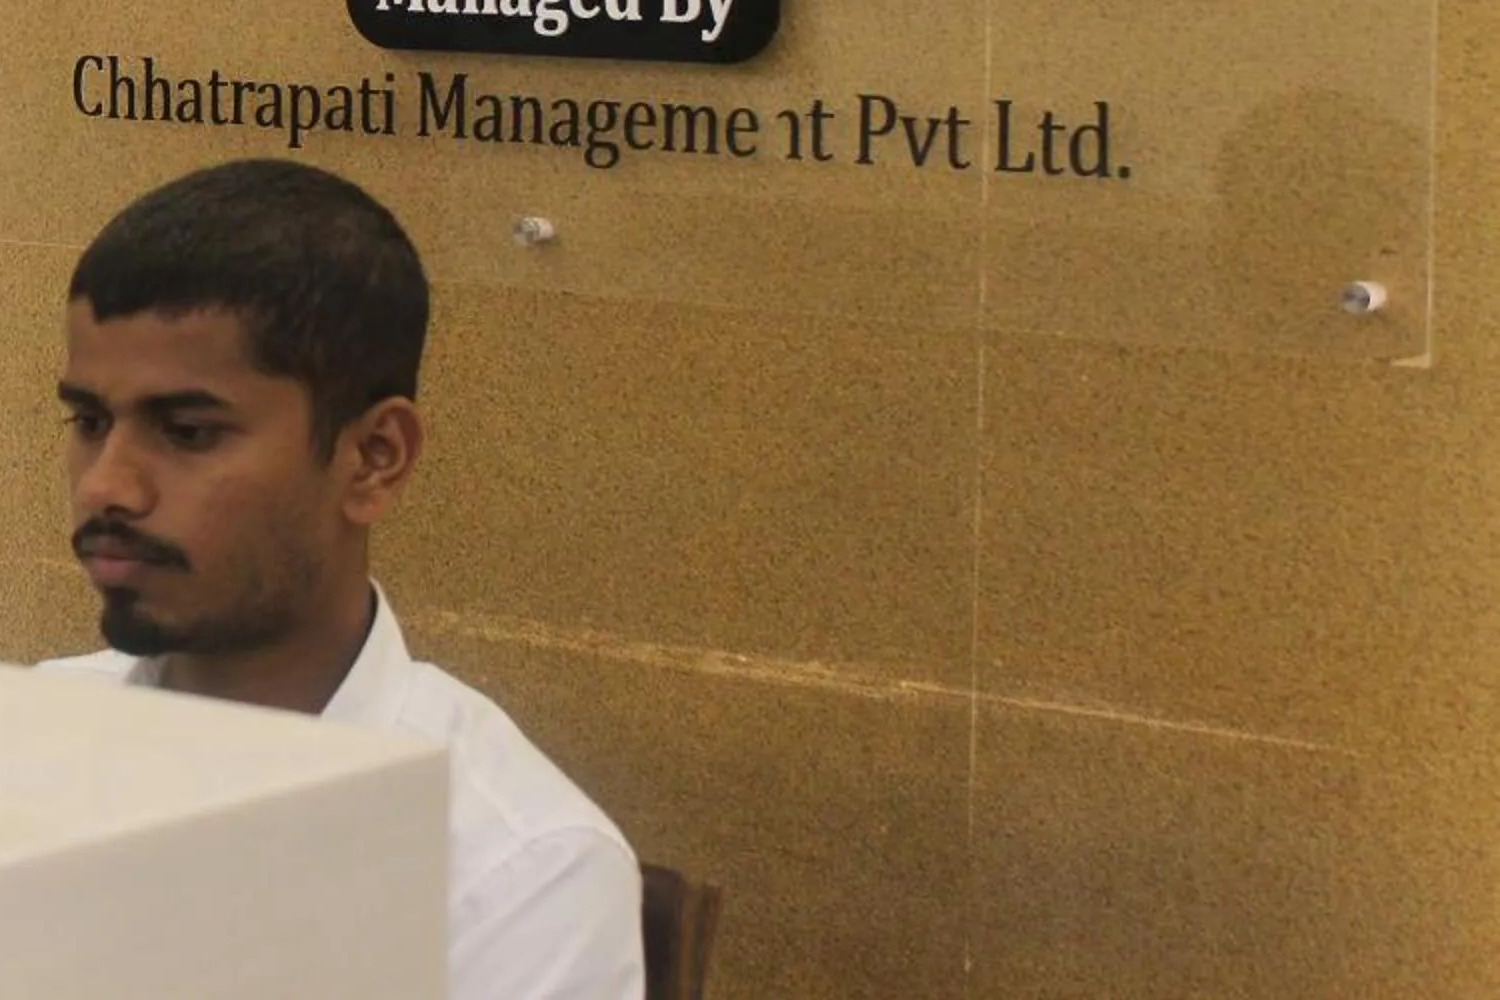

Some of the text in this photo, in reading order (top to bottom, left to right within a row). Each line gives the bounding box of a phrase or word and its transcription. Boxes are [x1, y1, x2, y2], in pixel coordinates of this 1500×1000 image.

[73, 54, 1132, 179] Chhatrapati Management Pvt Ltd.
